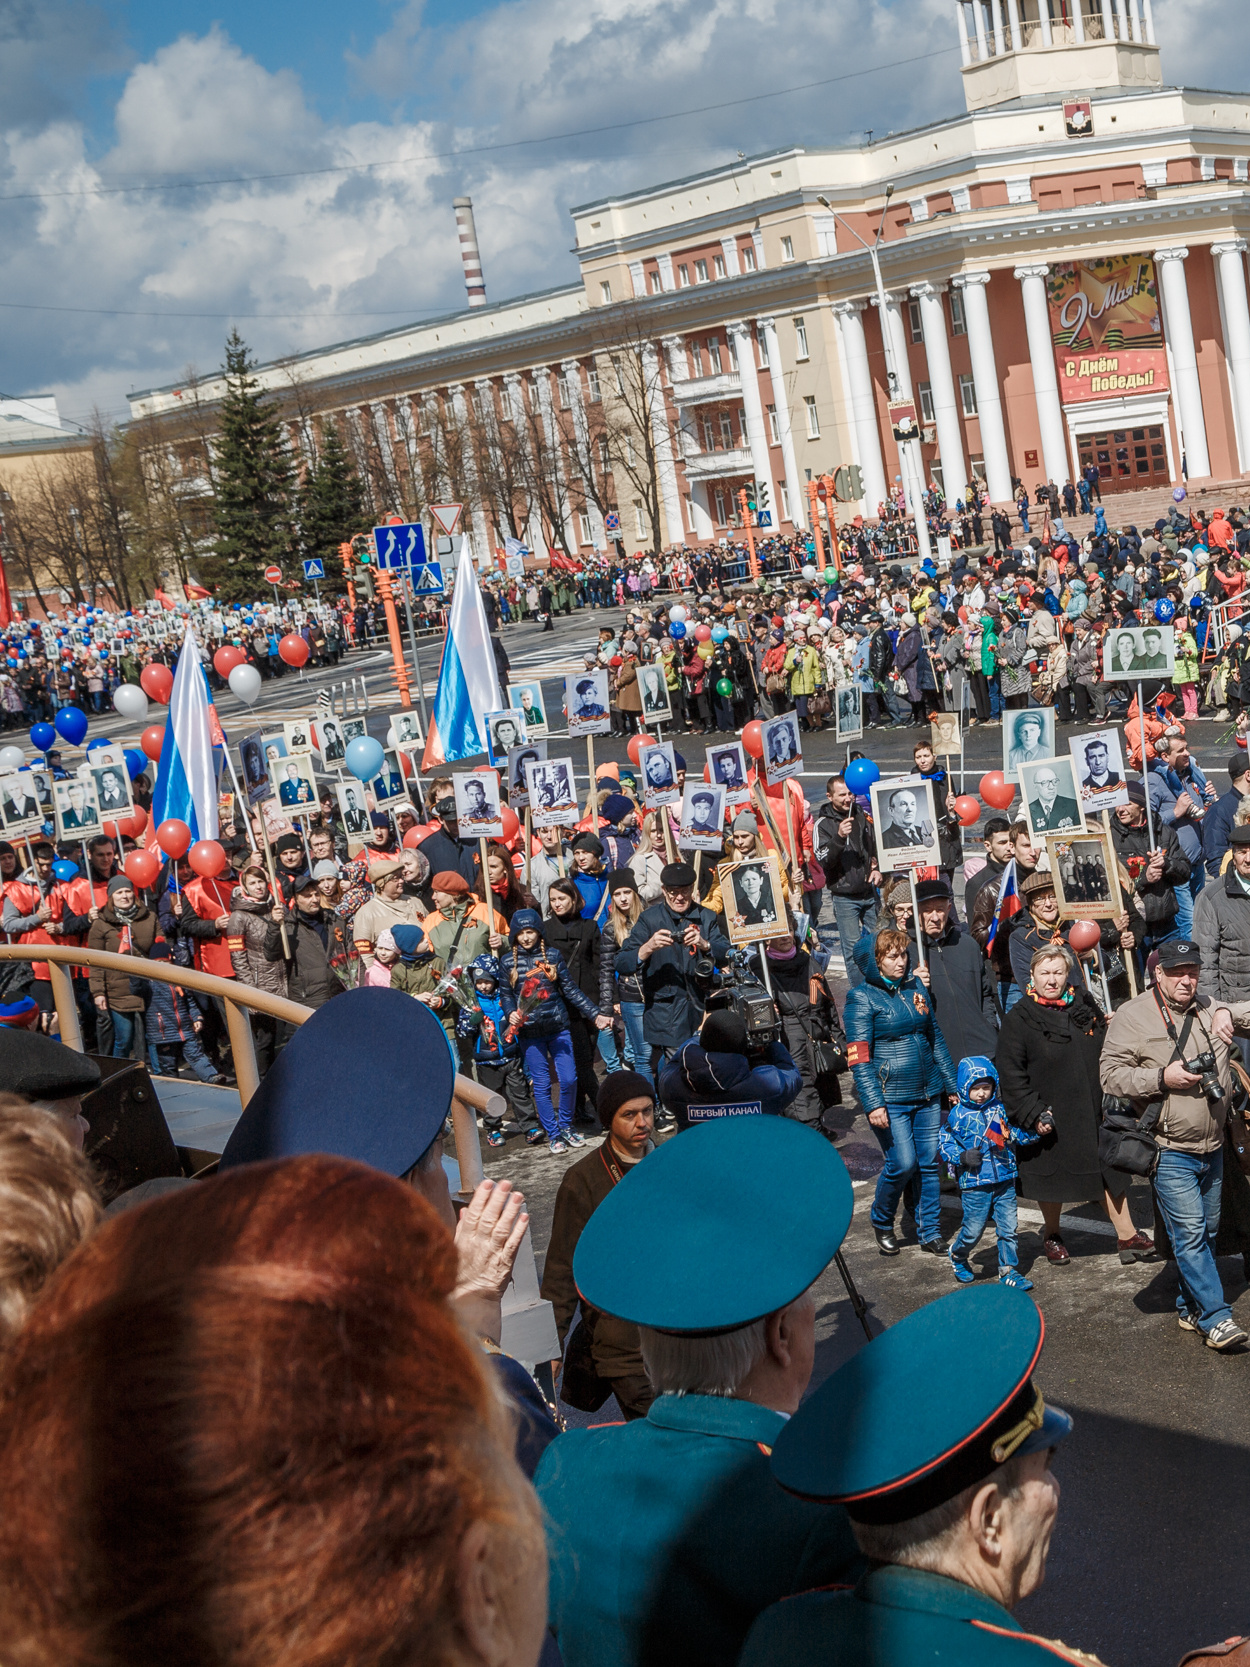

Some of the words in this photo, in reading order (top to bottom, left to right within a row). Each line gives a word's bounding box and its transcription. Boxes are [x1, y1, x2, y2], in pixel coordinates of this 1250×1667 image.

[1061, 292, 1088, 346] 9
[1088, 264, 1142, 318] Мая!
[1065, 361, 1076, 377] С
[1078, 357, 1118, 377] Днём
[1091, 369, 1154, 392] Победы!
[690, 1107, 727, 1117] ПЕРВЫЙ
[728, 1106, 759, 1116] КАНАЛ
[610, 1164, 621, 1182] Cano
